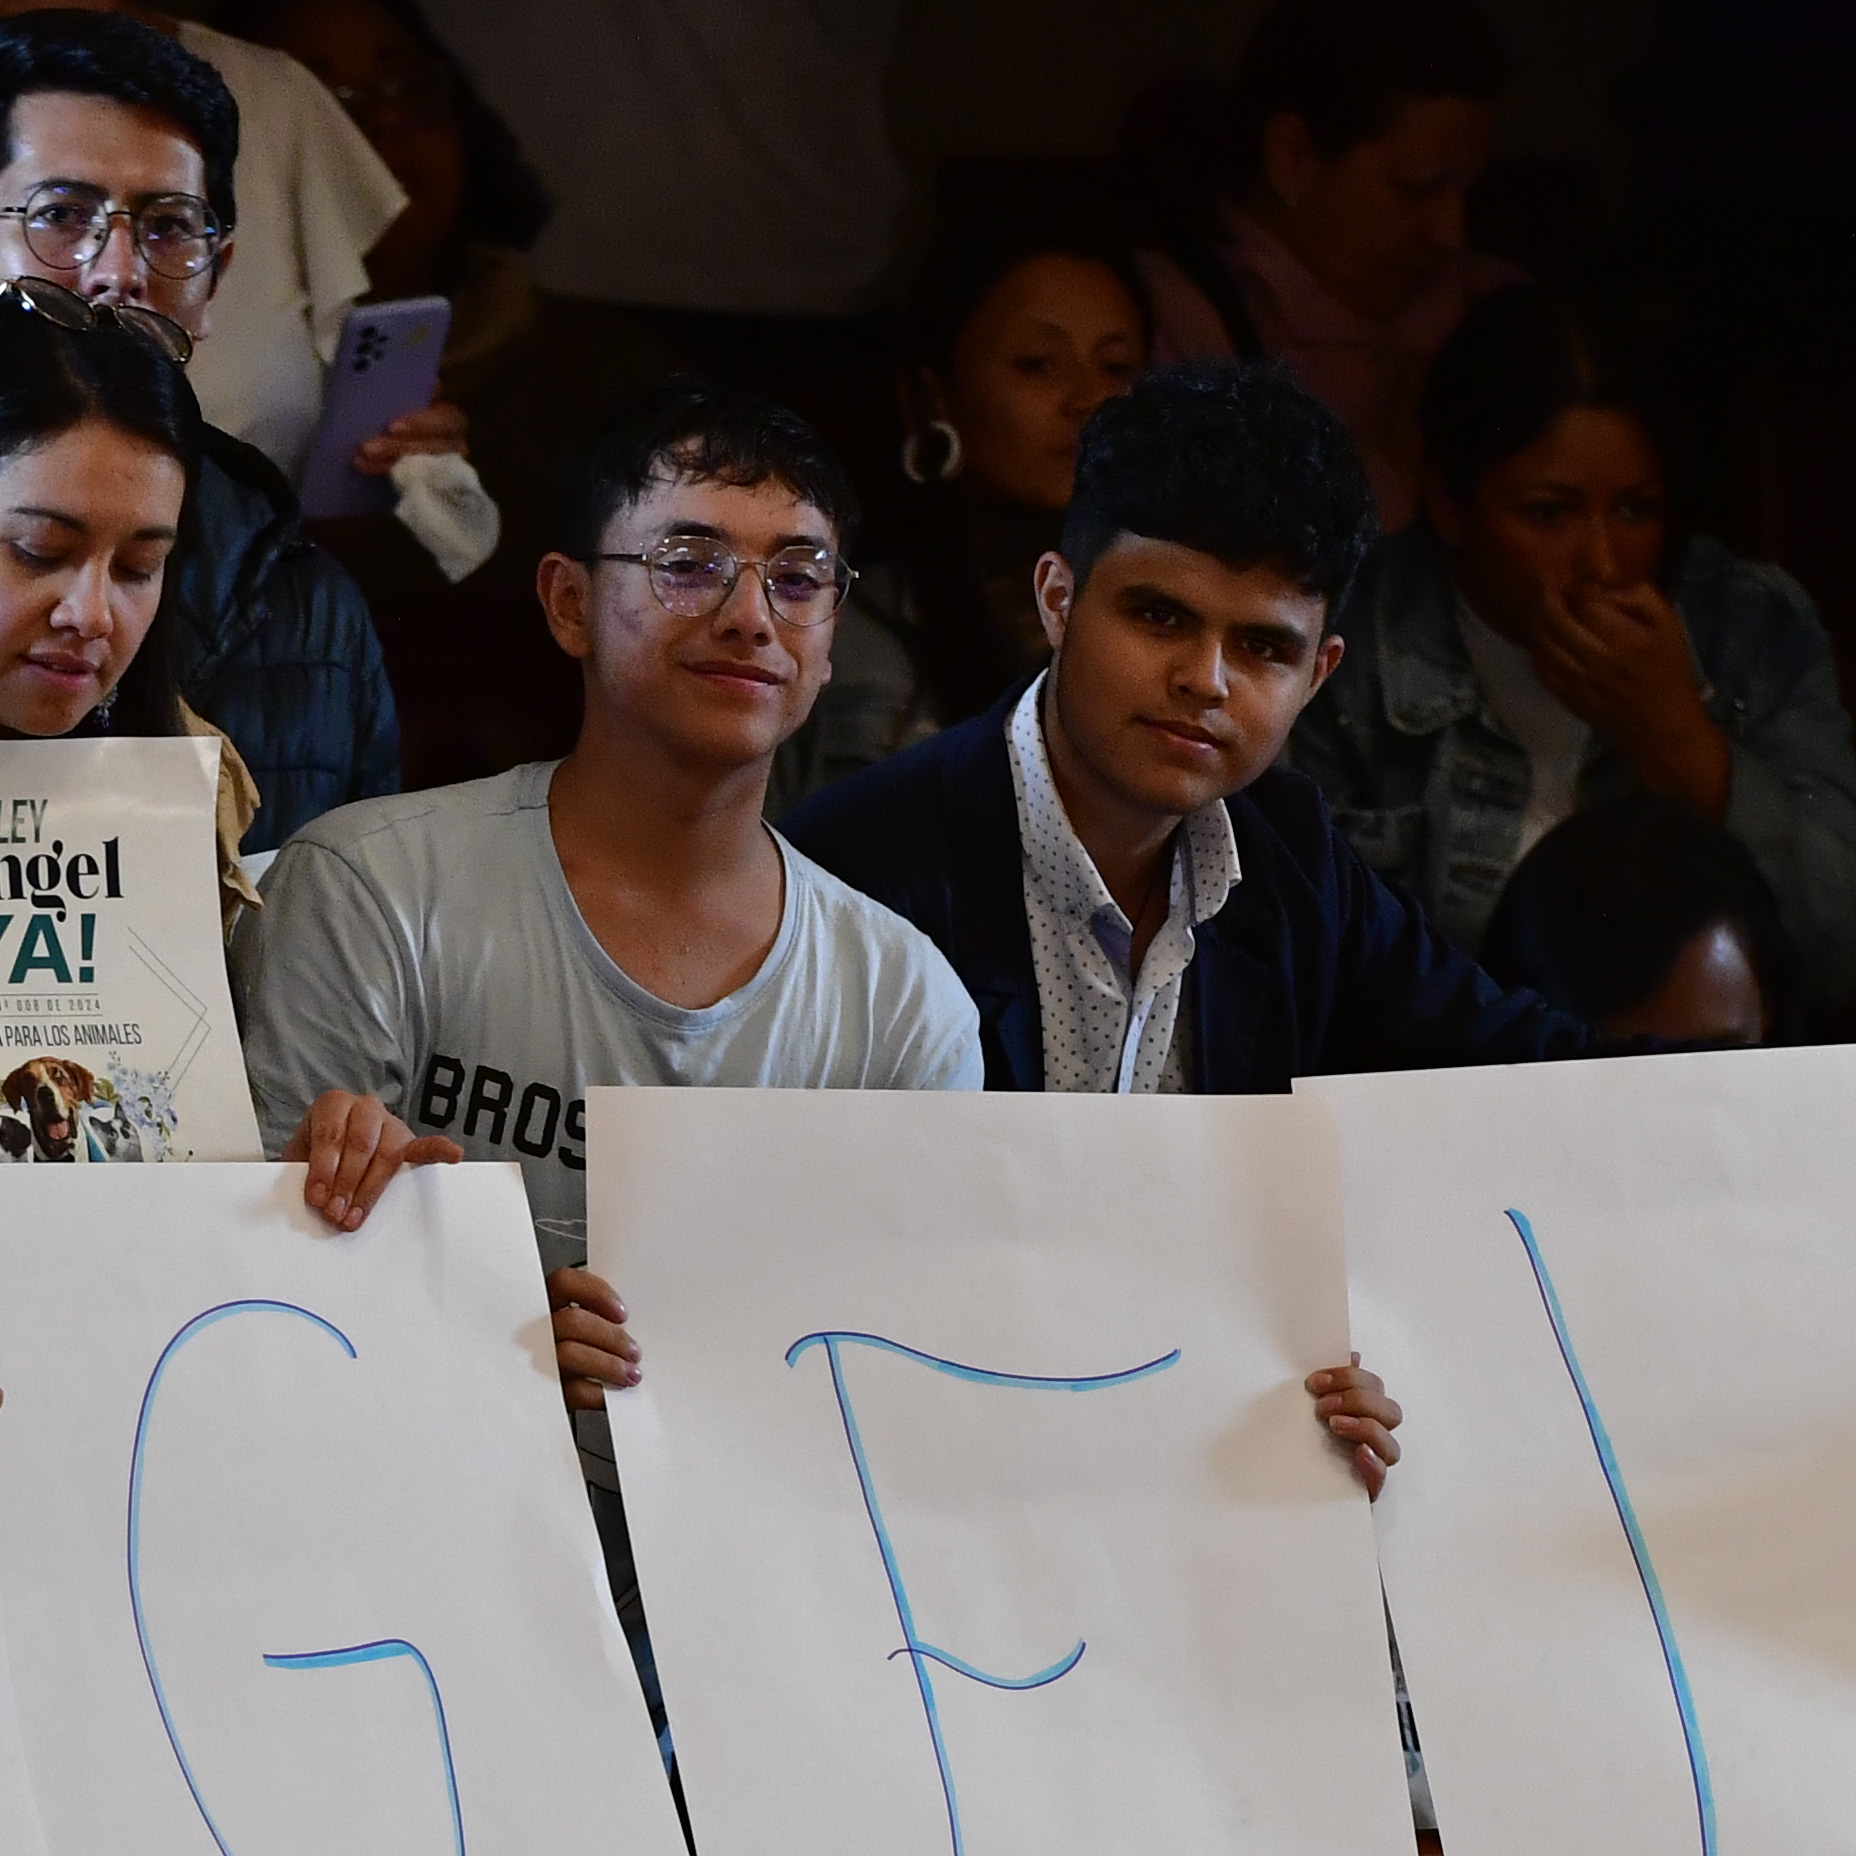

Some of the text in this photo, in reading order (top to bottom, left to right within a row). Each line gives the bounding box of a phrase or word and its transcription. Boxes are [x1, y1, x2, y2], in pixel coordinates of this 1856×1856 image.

[46, 999, 62, 1012] DE
[68, 997, 102, 1012] 2024
[4, 1023, 43, 1047] PARA
[43, 1023, 71, 1047] LOS
[74, 1022, 143, 1046] ANIMALES
